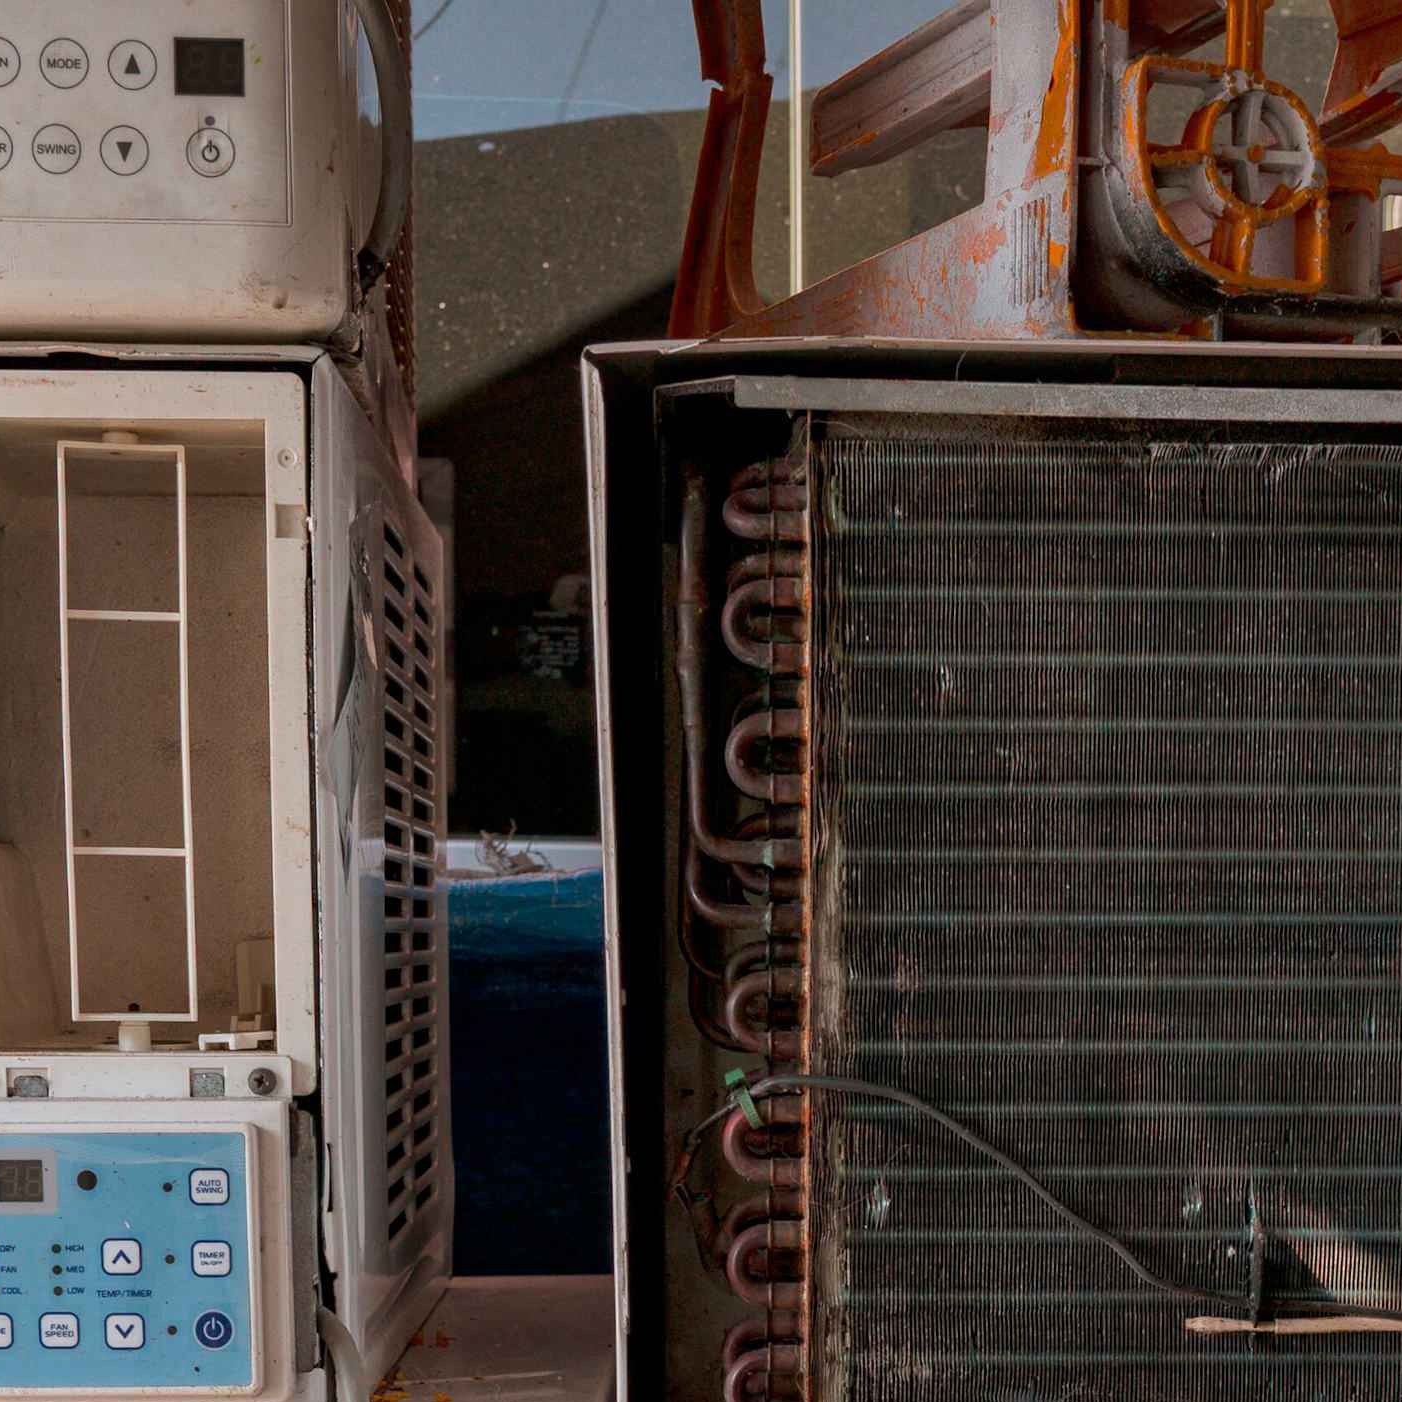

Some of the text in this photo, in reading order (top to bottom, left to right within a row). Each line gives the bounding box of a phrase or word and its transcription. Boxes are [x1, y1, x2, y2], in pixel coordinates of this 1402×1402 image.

[47, 58, 82, 70] MODE
[37, 143, 76, 155] SWING
[1, 1287, 23, 1295] COOL
[96, 1289, 152, 1298] TEMP/TIMER
